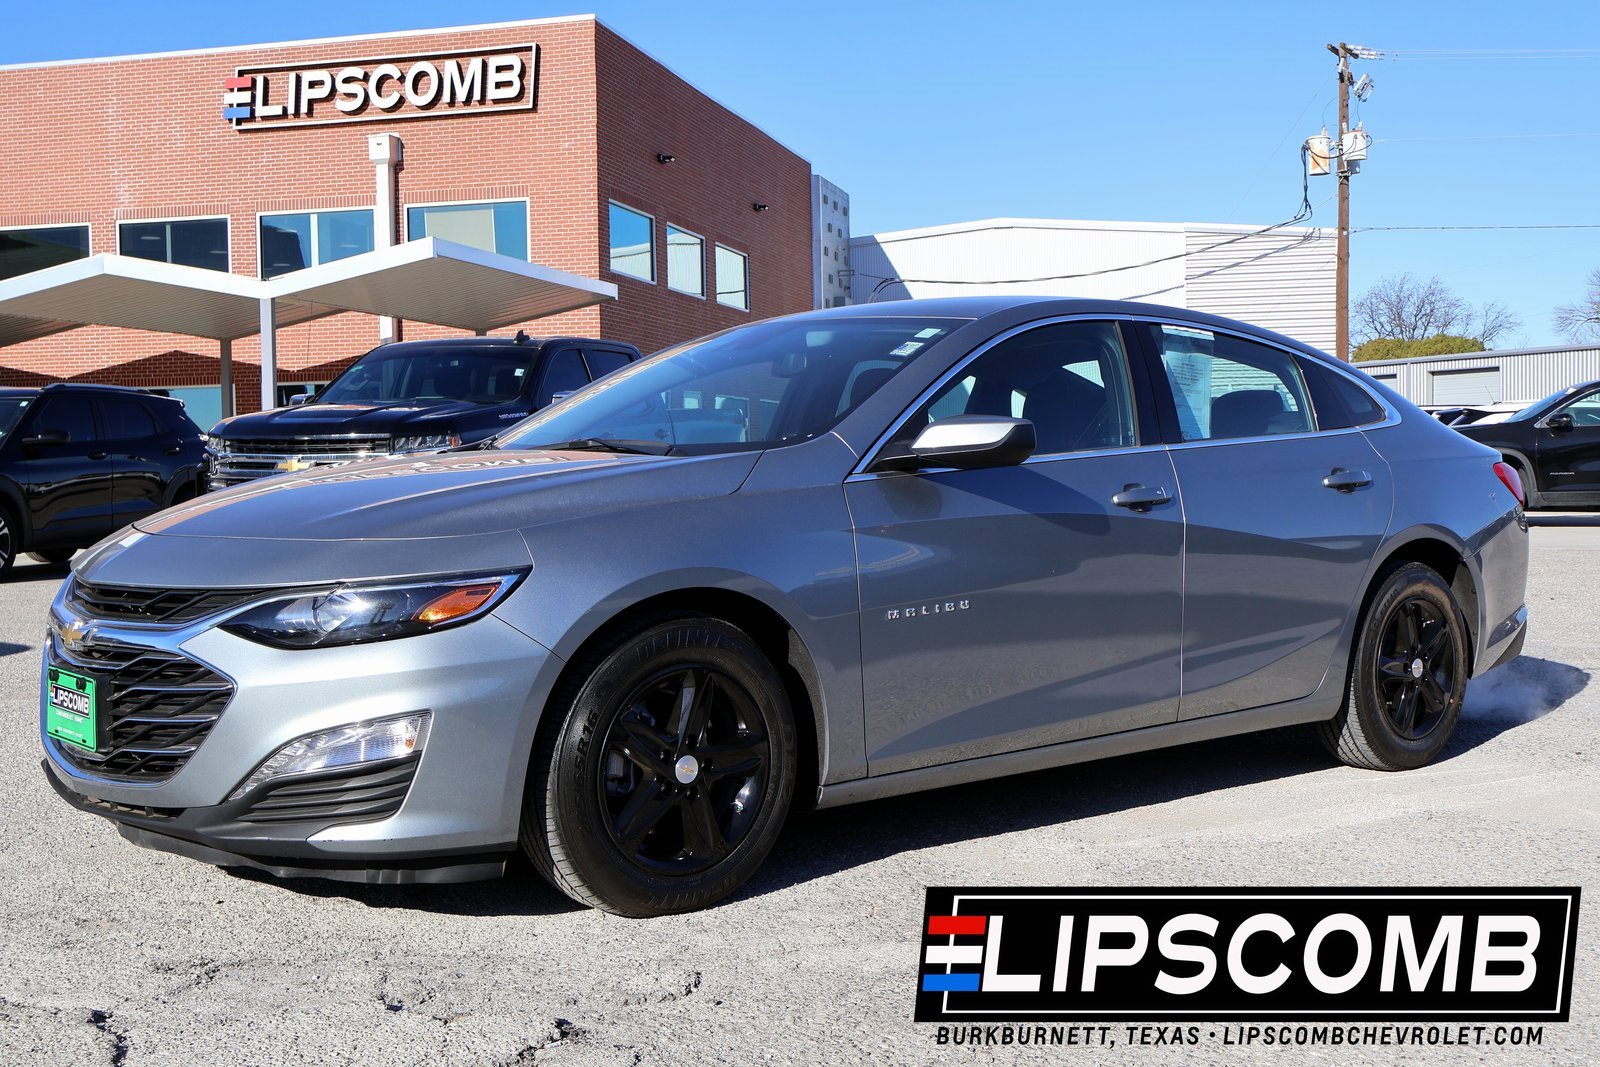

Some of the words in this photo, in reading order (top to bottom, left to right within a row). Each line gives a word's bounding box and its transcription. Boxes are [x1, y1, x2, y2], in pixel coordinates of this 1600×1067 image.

[254, 54, 523, 117] LIPSCOMB
[887, 600, 970, 620] MALIBU
[53, 687, 90, 715] LIPSCOMB
